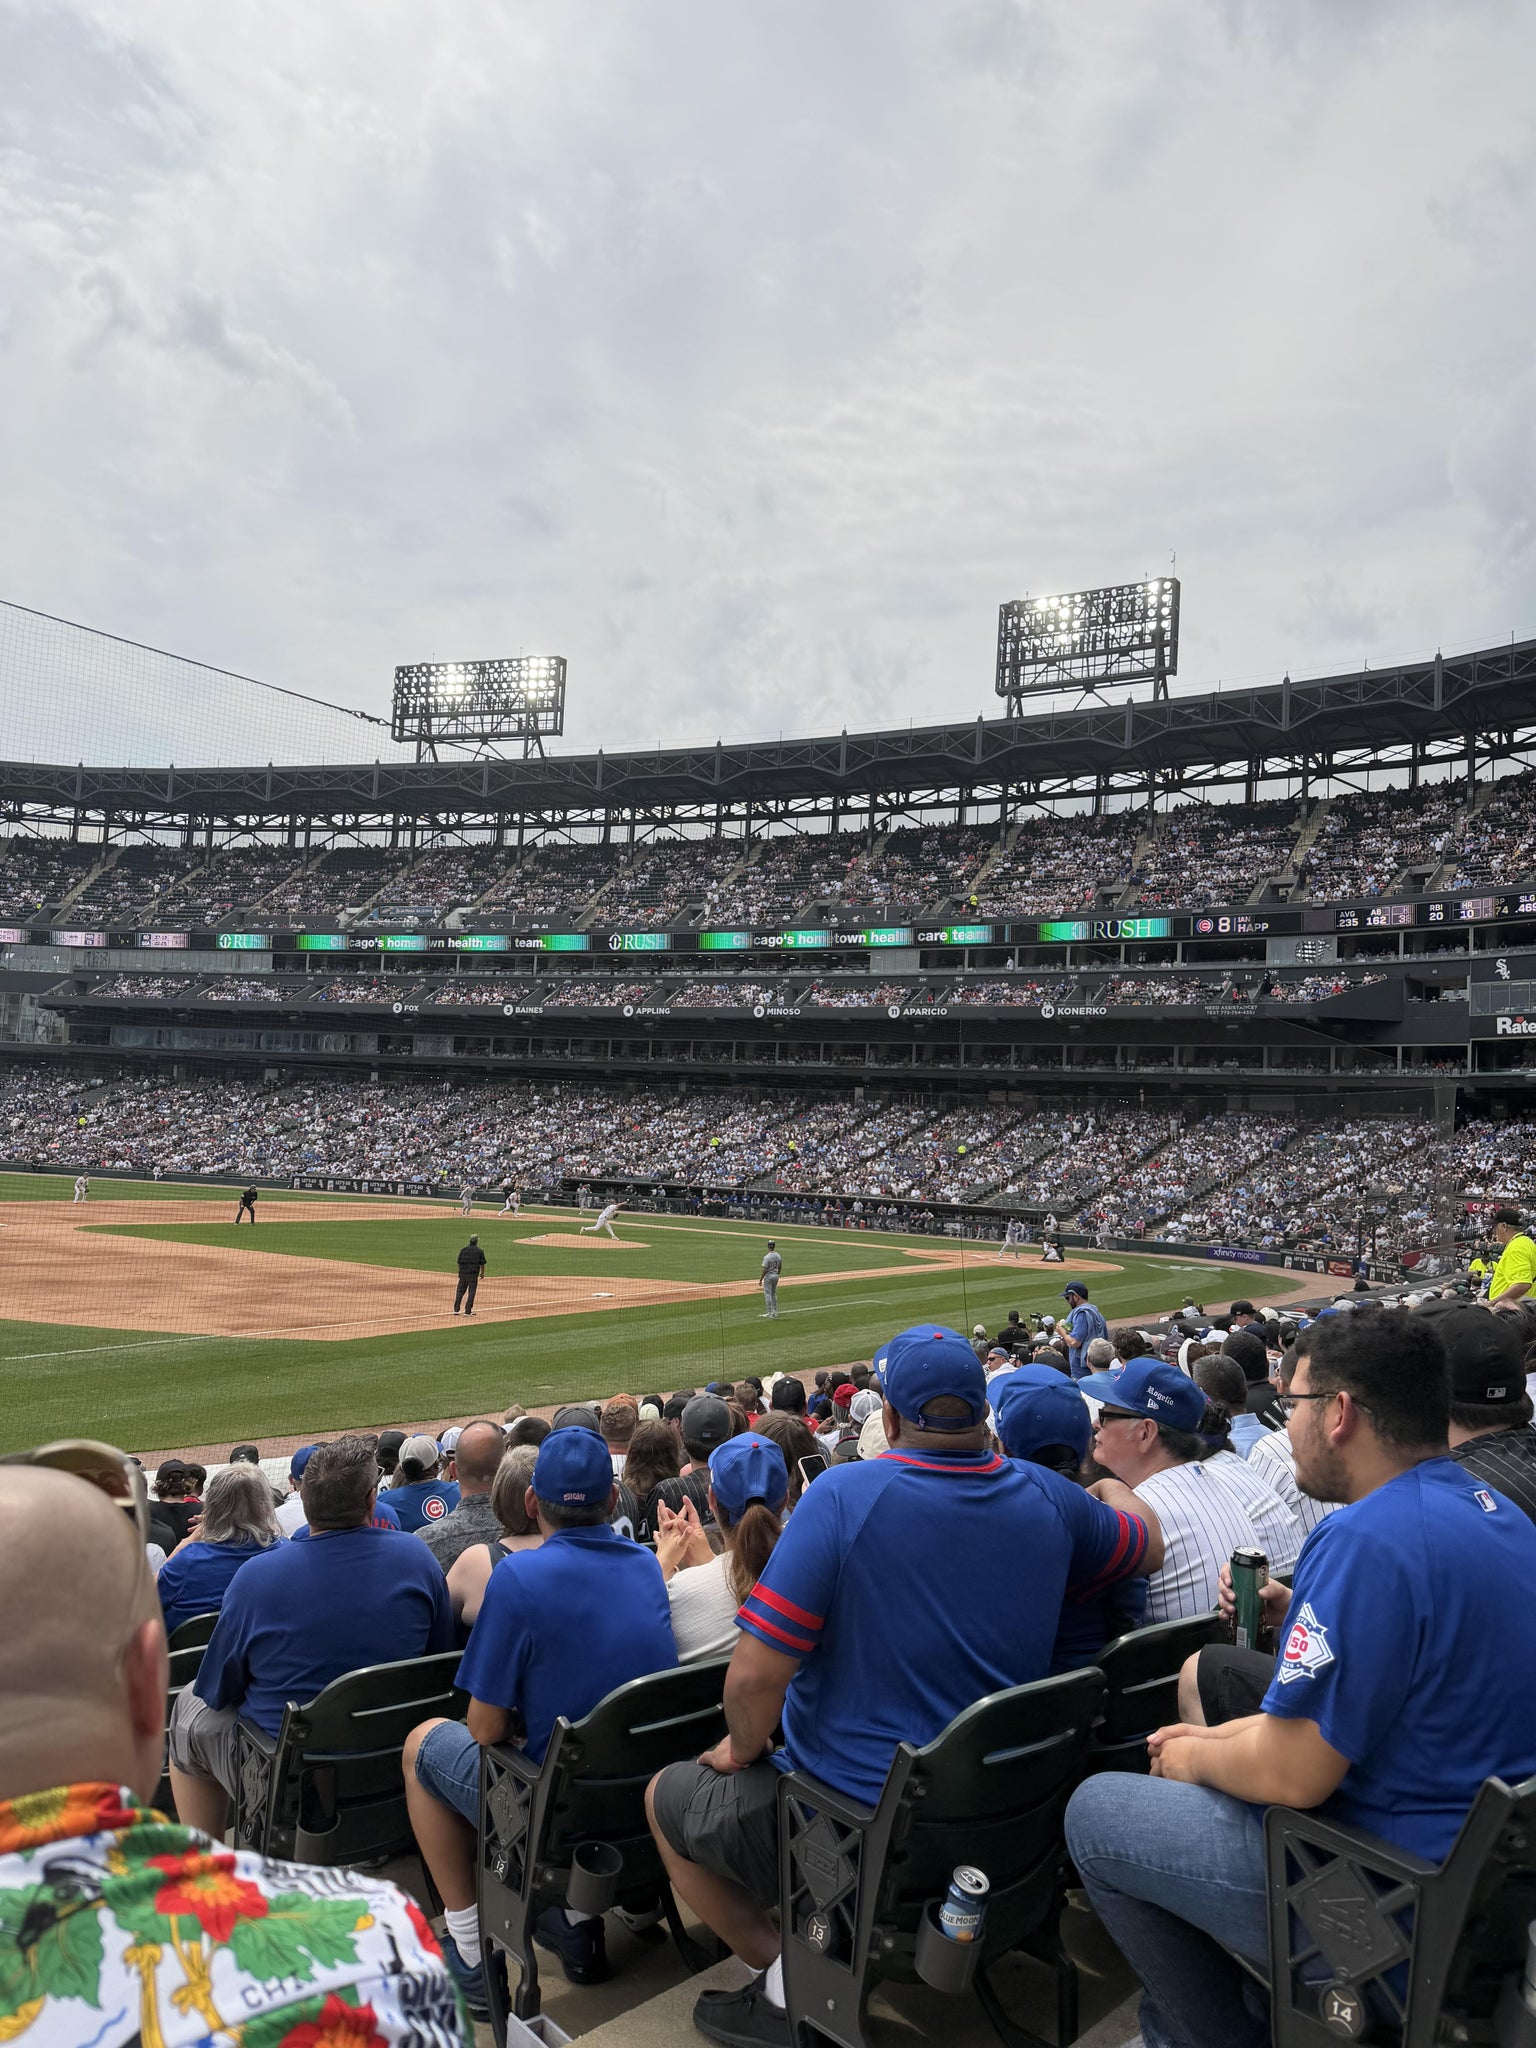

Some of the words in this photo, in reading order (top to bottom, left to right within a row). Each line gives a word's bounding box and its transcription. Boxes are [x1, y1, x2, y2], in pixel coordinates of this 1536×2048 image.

[1339, 910, 1356, 918] AVG
[1370, 908, 1382, 916] AB
[1430, 904, 1443, 912] RBI
[1462, 901, 1473, 909] HR
[1519, 894, 1535, 903] SLG
[1336, 918, 1359, 928] .235
[1366, 915, 1387, 926] 162
[1429, 911, 1444, 922] 20
[1460, 908, 1475, 919] 10
[1093, 919, 1152, 939] RUSH
[1218, 917, 1231, 933] 8
[1238, 922, 1269, 933] HAPP
[447, 937, 483, 948] health
[514, 938, 546, 948] team.
[918, 931, 948, 941] care
[404, 1004, 420, 1012] FOX
[515, 1006, 544, 1015] BAINES
[636, 1006, 671, 1015] APPLING
[767, 1007, 800, 1016] MINOSO
[903, 1007, 948, 1016] APARICIO
[1057, 1006, 1107, 1016] KONERKO
[1496, 1016, 1536, 1035] Rate
[1213, 1248, 1237, 1259] xfinity
[1237, 1251, 1260, 1261] mobile
[1146, 1386, 1174, 1406] Rogelio
[496, 1860, 505, 1874] 12
[940, 1910, 955, 1924] BLUE
[955, 1915, 979, 1925] MOON
[812, 1924, 824, 1941] 13
[1332, 2001, 1353, 2023] 14
